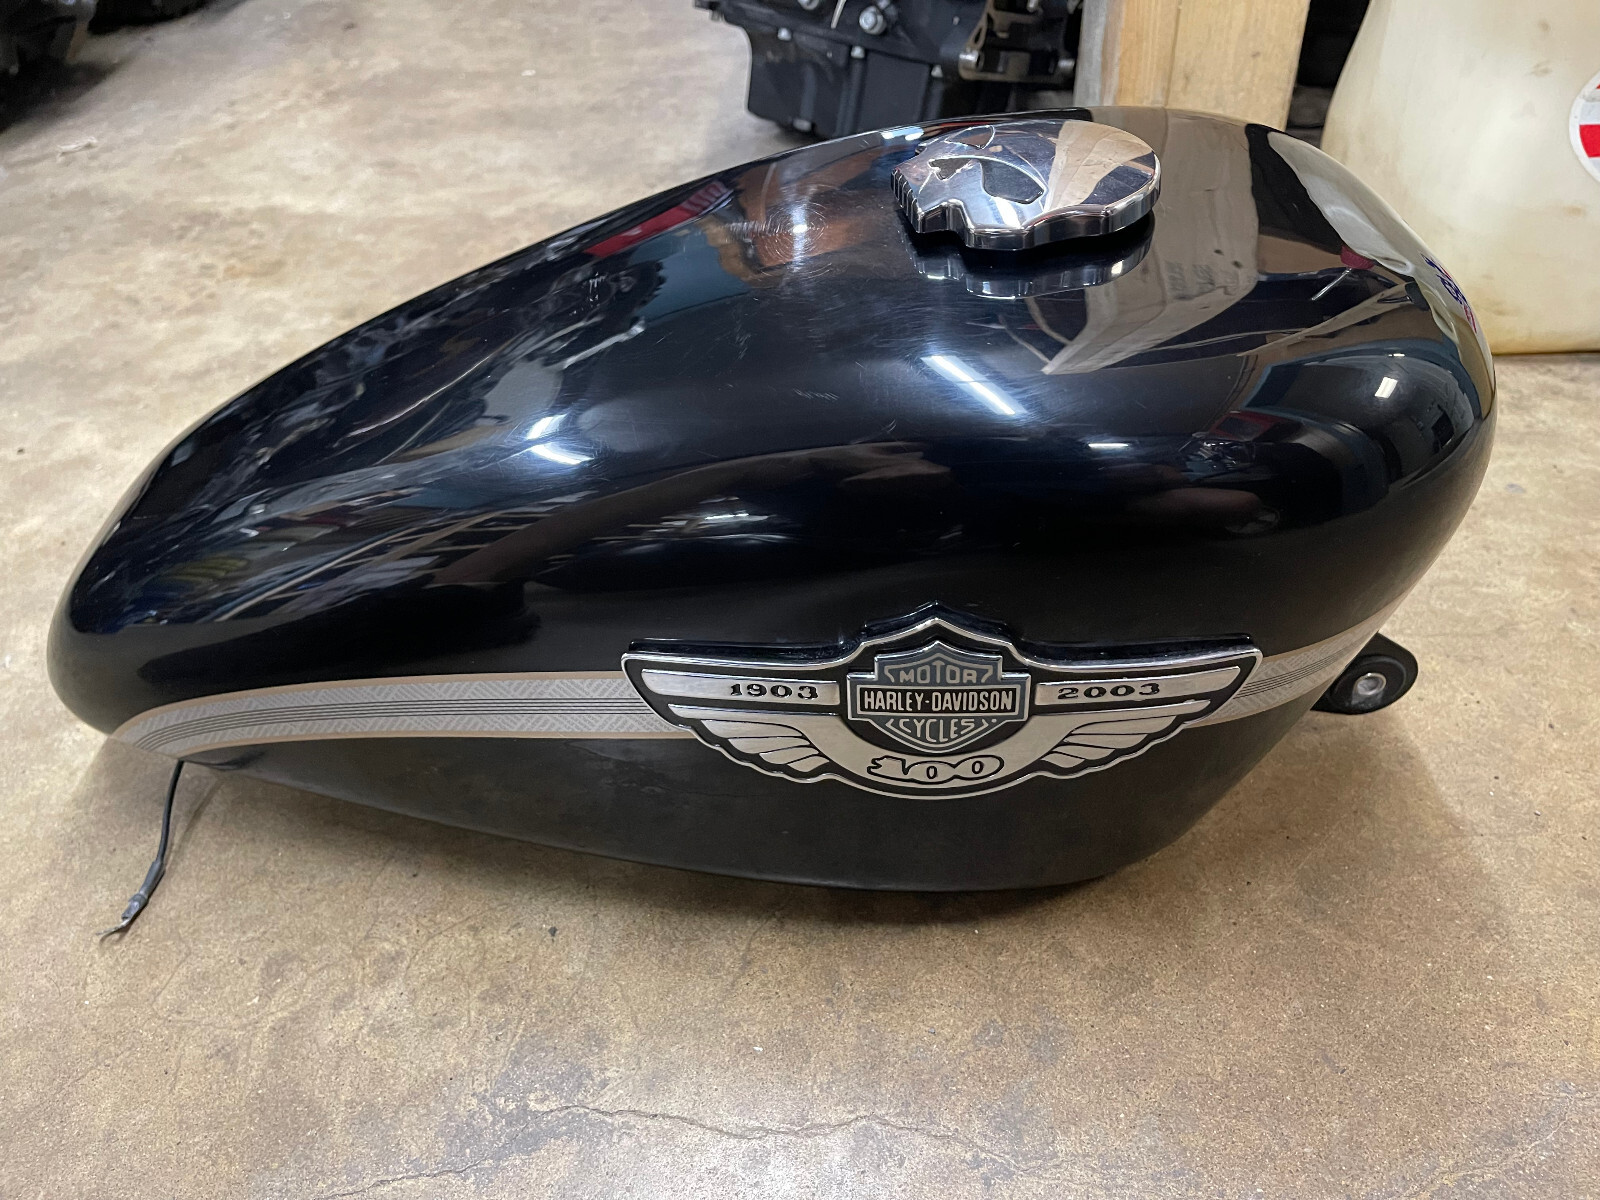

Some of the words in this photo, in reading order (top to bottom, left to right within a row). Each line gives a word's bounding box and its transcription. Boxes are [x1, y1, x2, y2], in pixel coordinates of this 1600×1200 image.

[899, 660, 977, 684] MOTOR
[730, 683, 819, 699] 1903
[863, 690, 1013, 711] HARLEY-DAVIDSON
[1057, 682, 1160, 700] 2003
[899, 718, 975, 743] CYCLES
